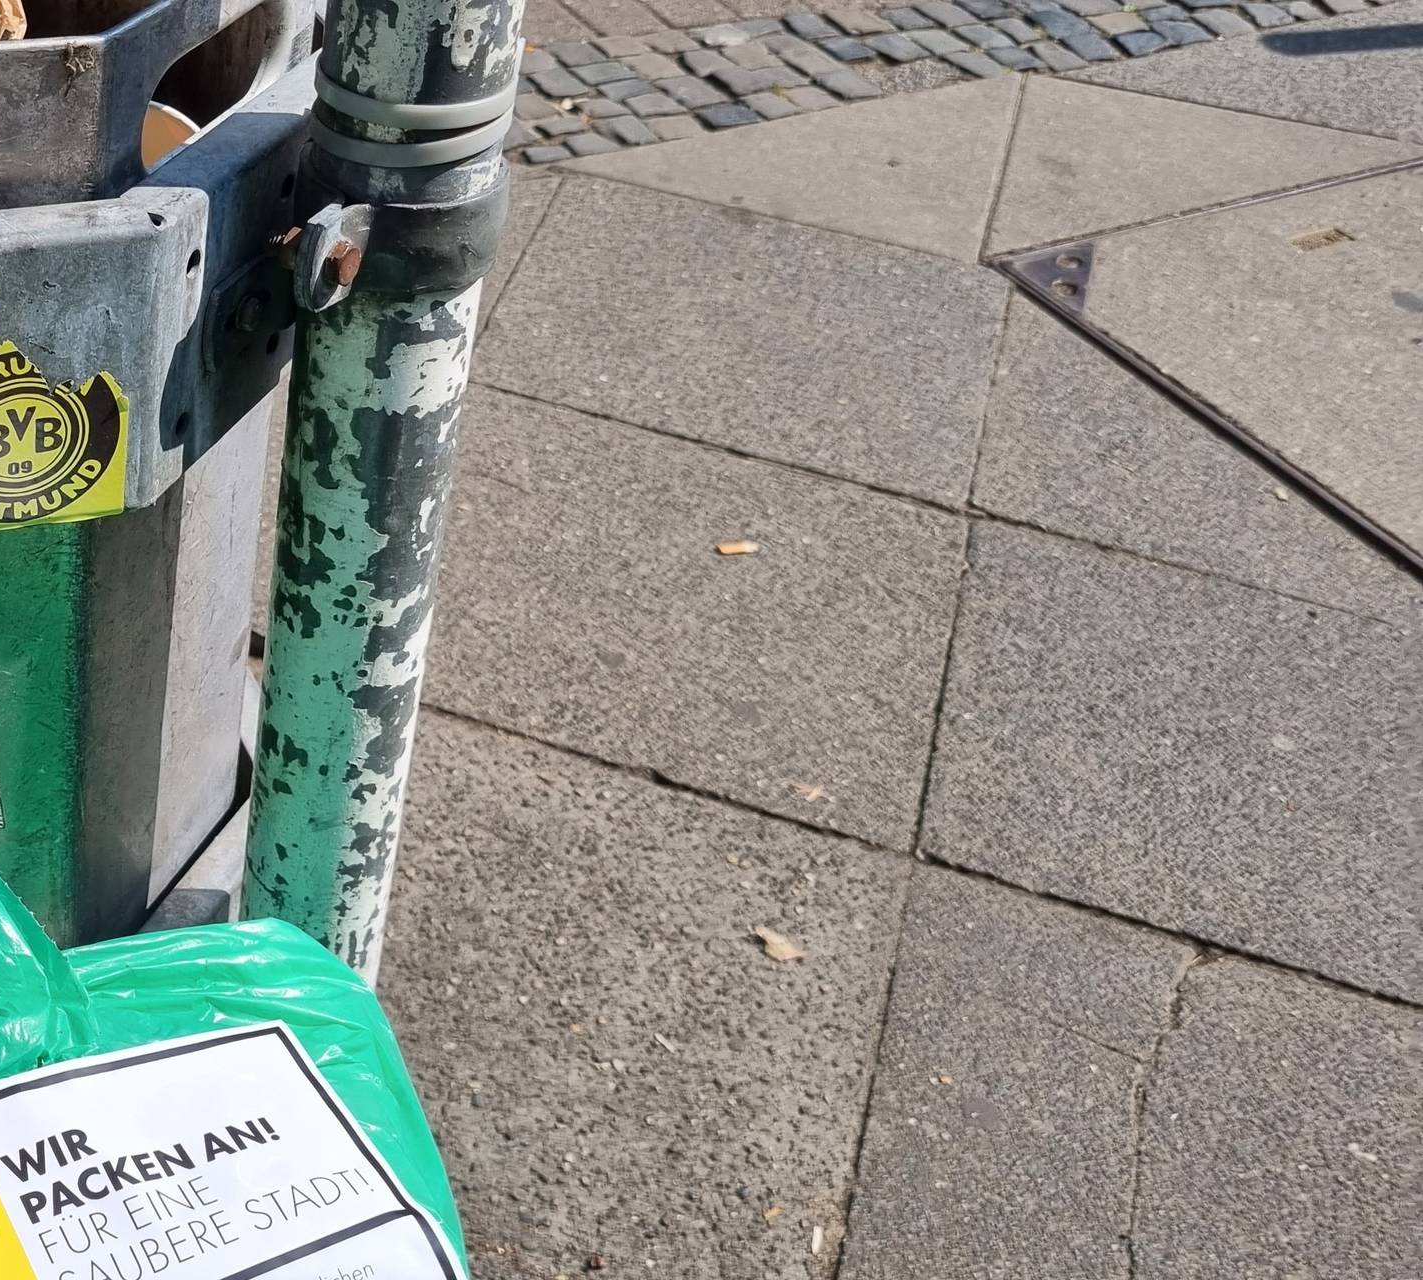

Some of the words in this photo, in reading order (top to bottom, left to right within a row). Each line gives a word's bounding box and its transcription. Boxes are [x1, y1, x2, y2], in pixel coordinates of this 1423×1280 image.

[7, 460, 33, 476] 09
[0, 1128, 98, 1183] WIR
[19, 1143, 196, 1225] PACKEN
[203, 1117, 281, 1163] AN!
[39, 1211, 119, 1264] FÜR
[123, 1175, 218, 1231] EINE
[58, 1210, 240, 1280] AUBERE
[244, 1167, 375, 1231] STADT!
